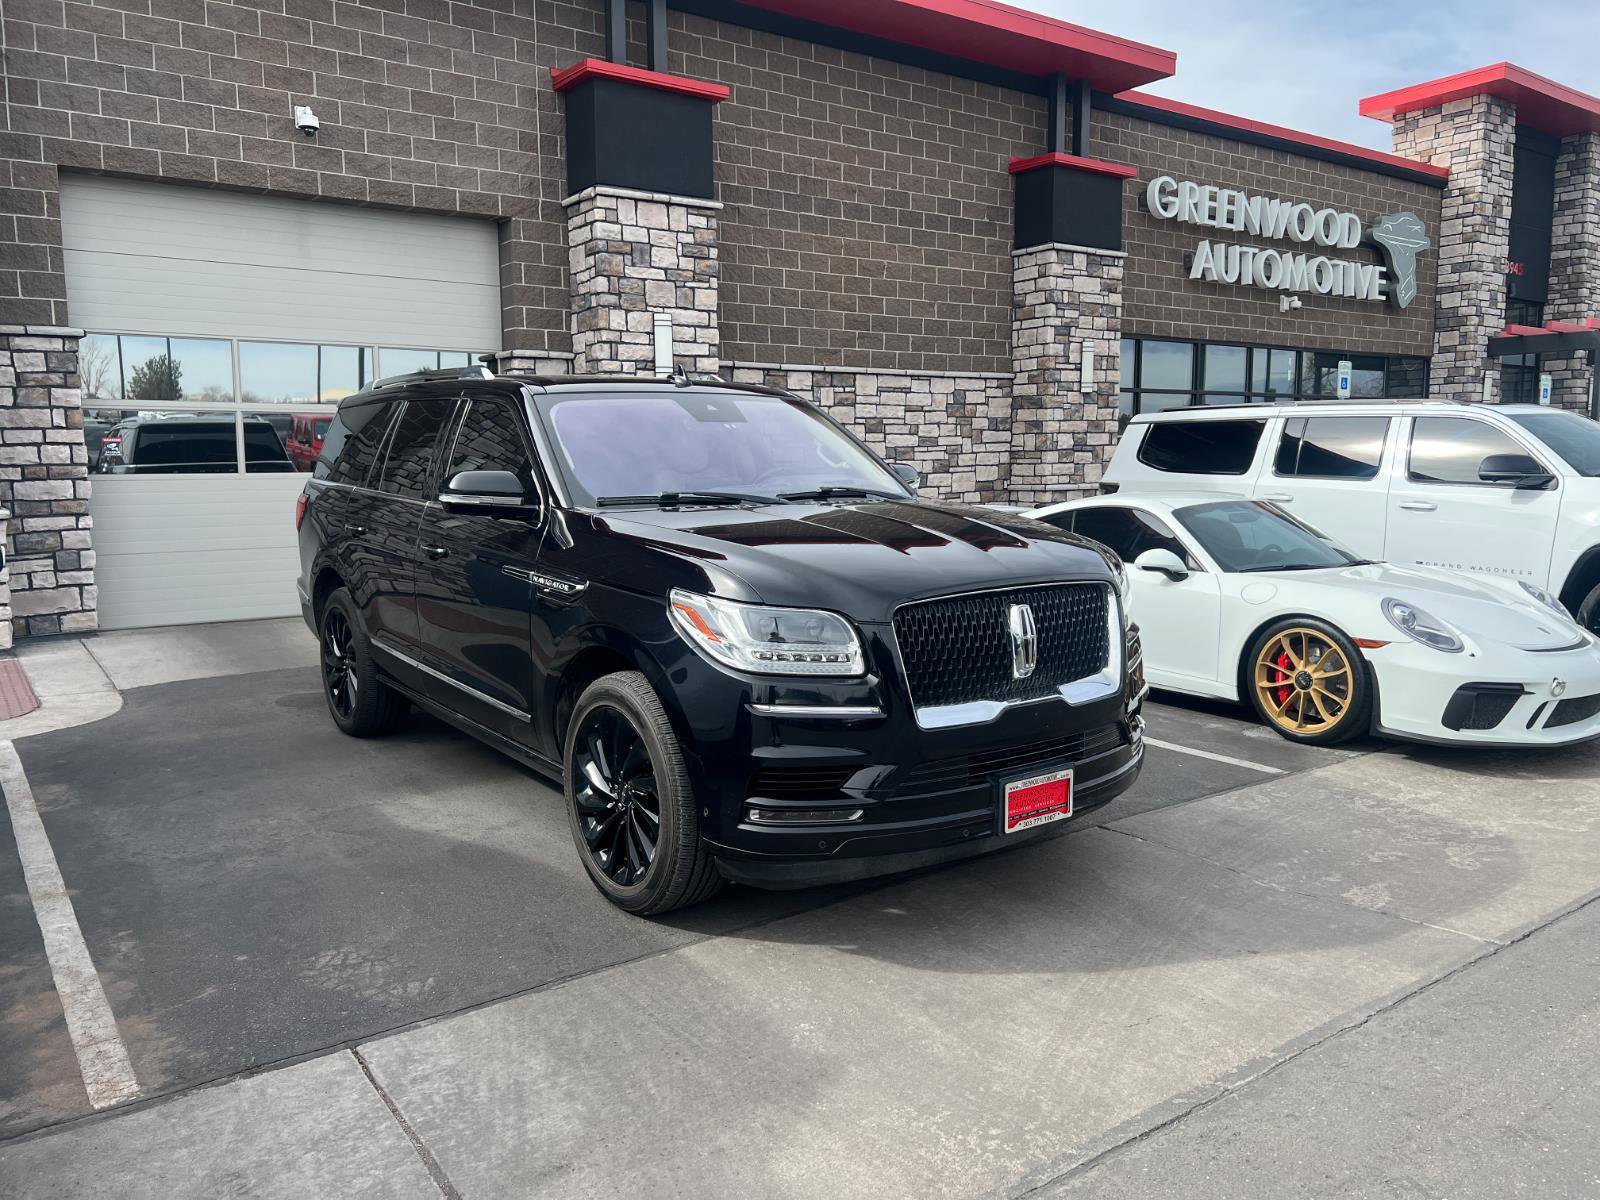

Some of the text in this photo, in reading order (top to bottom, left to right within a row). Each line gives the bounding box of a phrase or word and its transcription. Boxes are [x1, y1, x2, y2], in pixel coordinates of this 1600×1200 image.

[1147, 176, 1361, 248] GREENWOOD
[1189, 240, 1387, 301] AUTOMOTIVE
[532, 576, 569, 591] NAVIGATOR
[1425, 561, 1534, 575] GRAND WAGONEER
